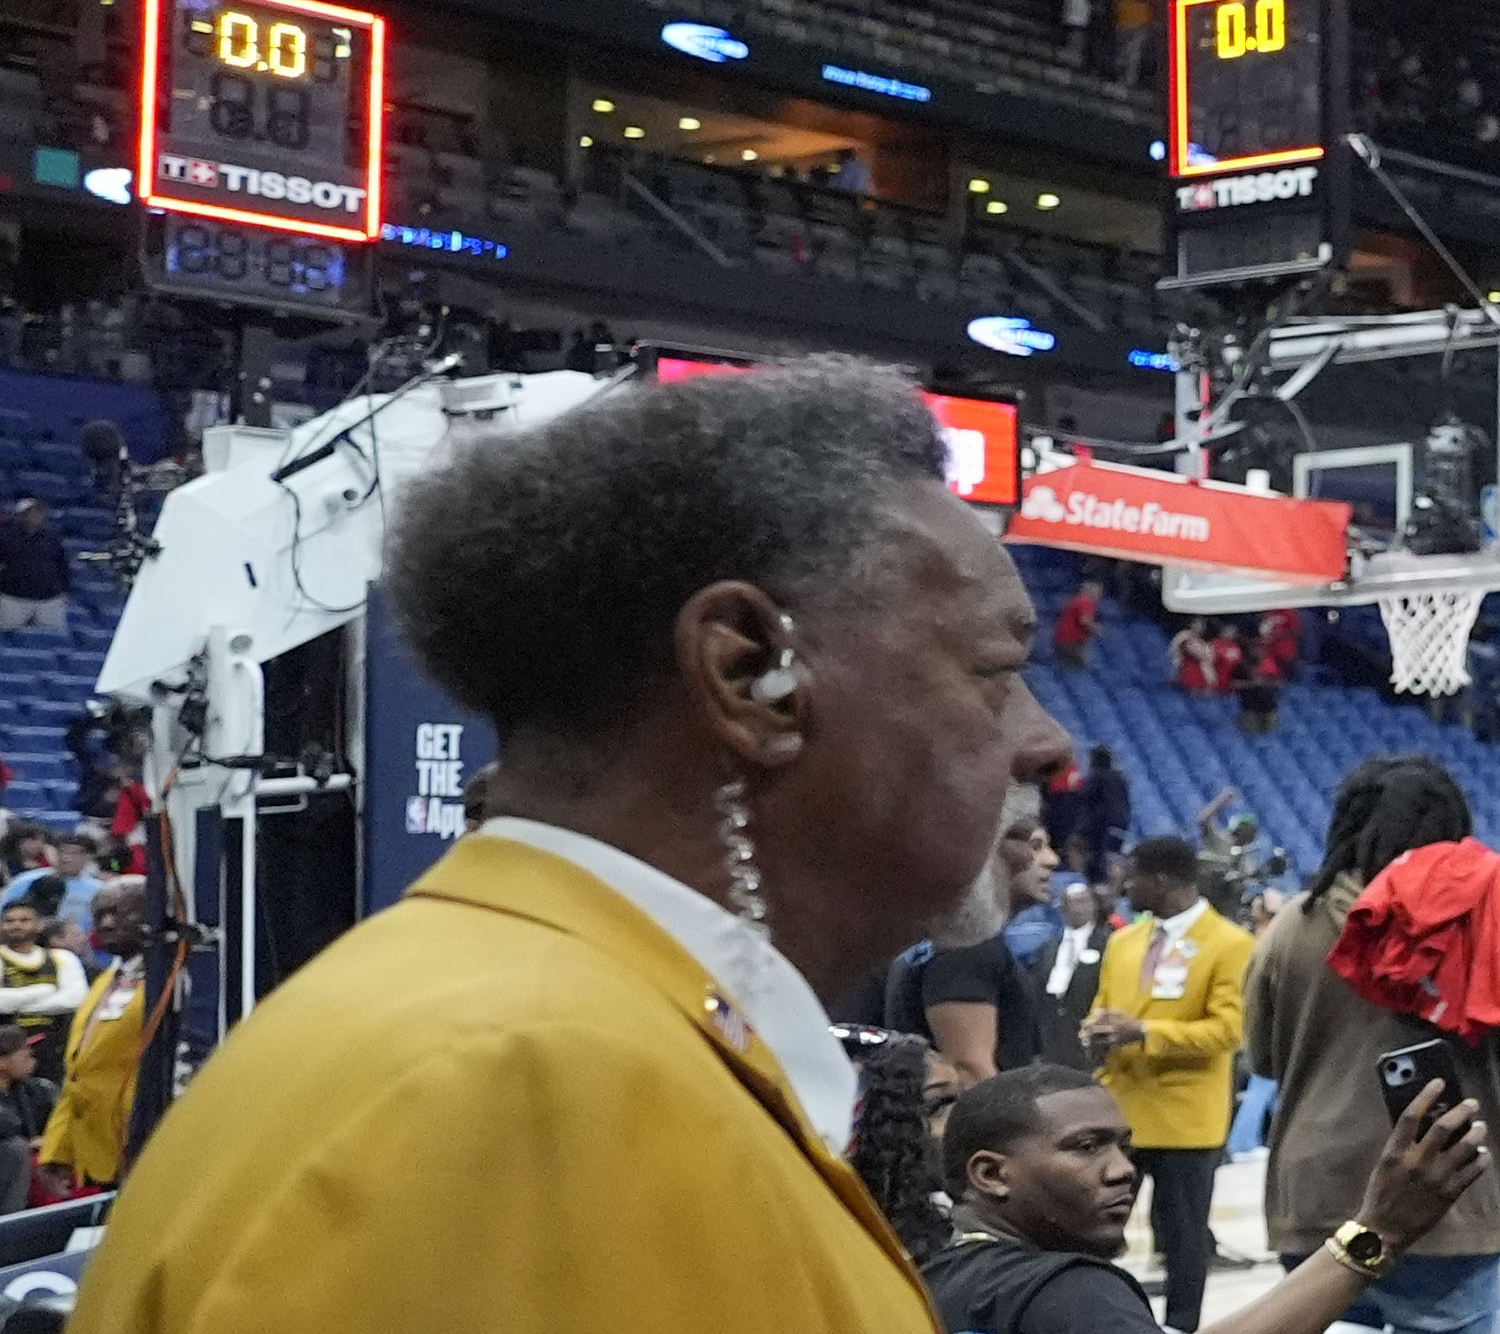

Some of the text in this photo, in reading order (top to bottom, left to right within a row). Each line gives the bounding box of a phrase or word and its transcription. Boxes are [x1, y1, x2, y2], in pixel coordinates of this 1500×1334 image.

[217, 10, 308, 79] 0.0
[217, 162, 368, 214] TISSOT
[1211, 165, 1319, 208] TISSOT
[415, 722, 465, 761] GET
[415, 759, 465, 798] THE
